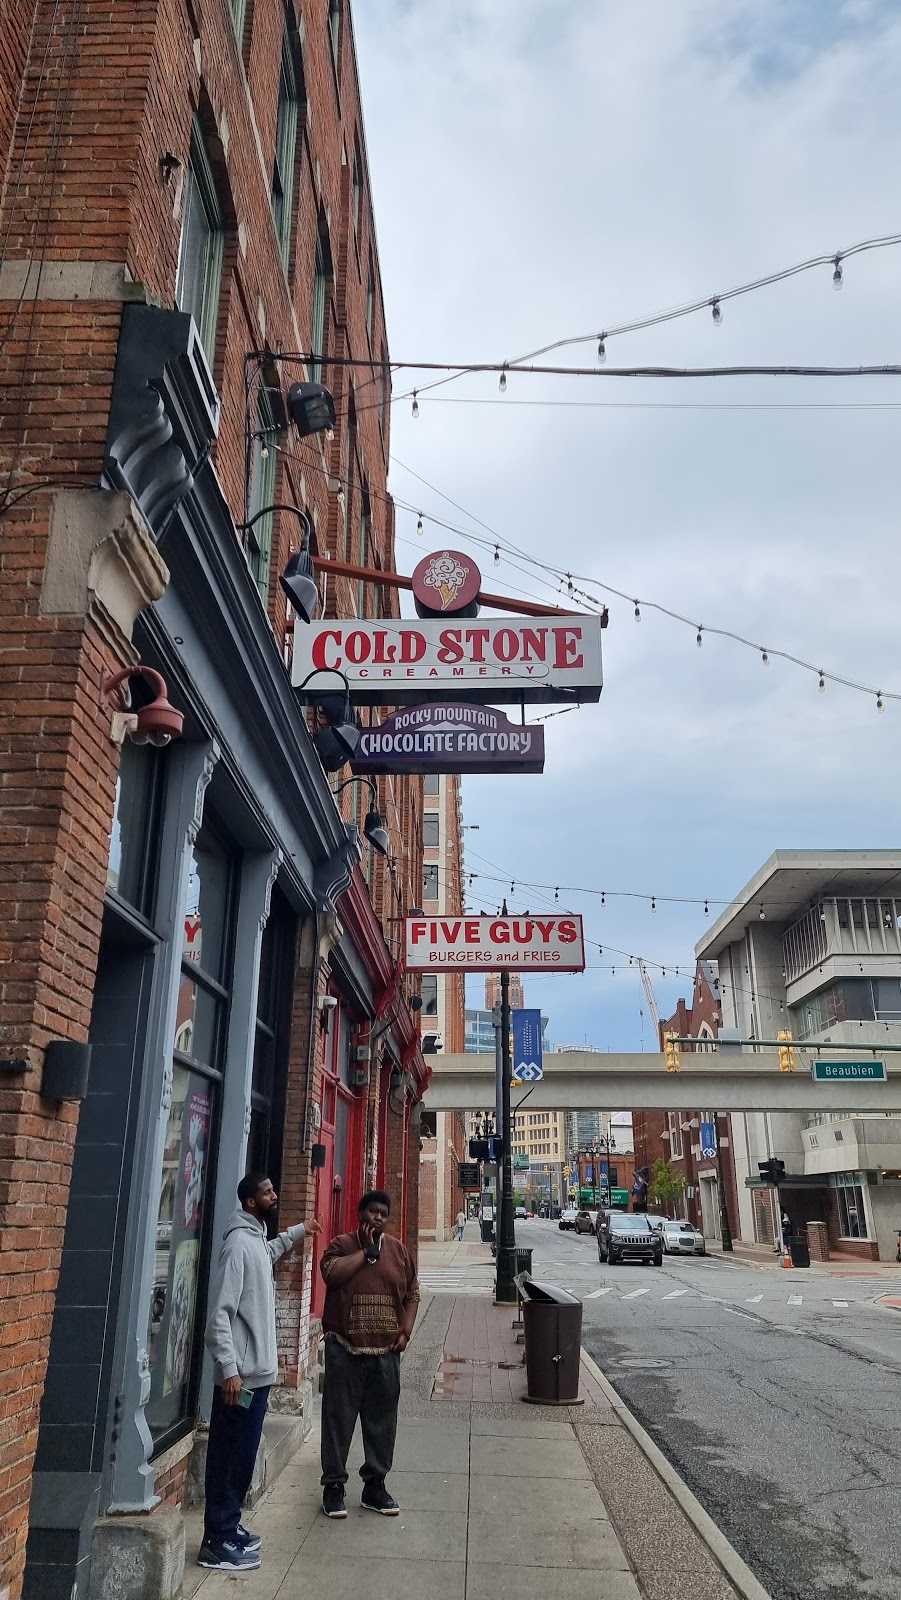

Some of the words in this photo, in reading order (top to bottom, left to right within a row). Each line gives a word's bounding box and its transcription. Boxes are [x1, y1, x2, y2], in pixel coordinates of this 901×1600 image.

[311, 630, 427, 670] COLD
[436, 627, 584, 669] STONE
[359, 666, 536, 677] CREAMERY
[394, 708, 431, 731] ROCKY
[434, 706, 498, 729] MOUNTAIN
[360, 732, 454, 756] CHOCOLATE
[457, 732, 532, 755] FACTORY
[411, 921, 481, 944] FIVE
[489, 920, 577, 944] GUYS
[429, 951, 492, 962] BURGERS
[496, 951, 519, 962] and
[523, 951, 561, 962] FRIES
[825, 1065, 874, 1076] Beaubien
